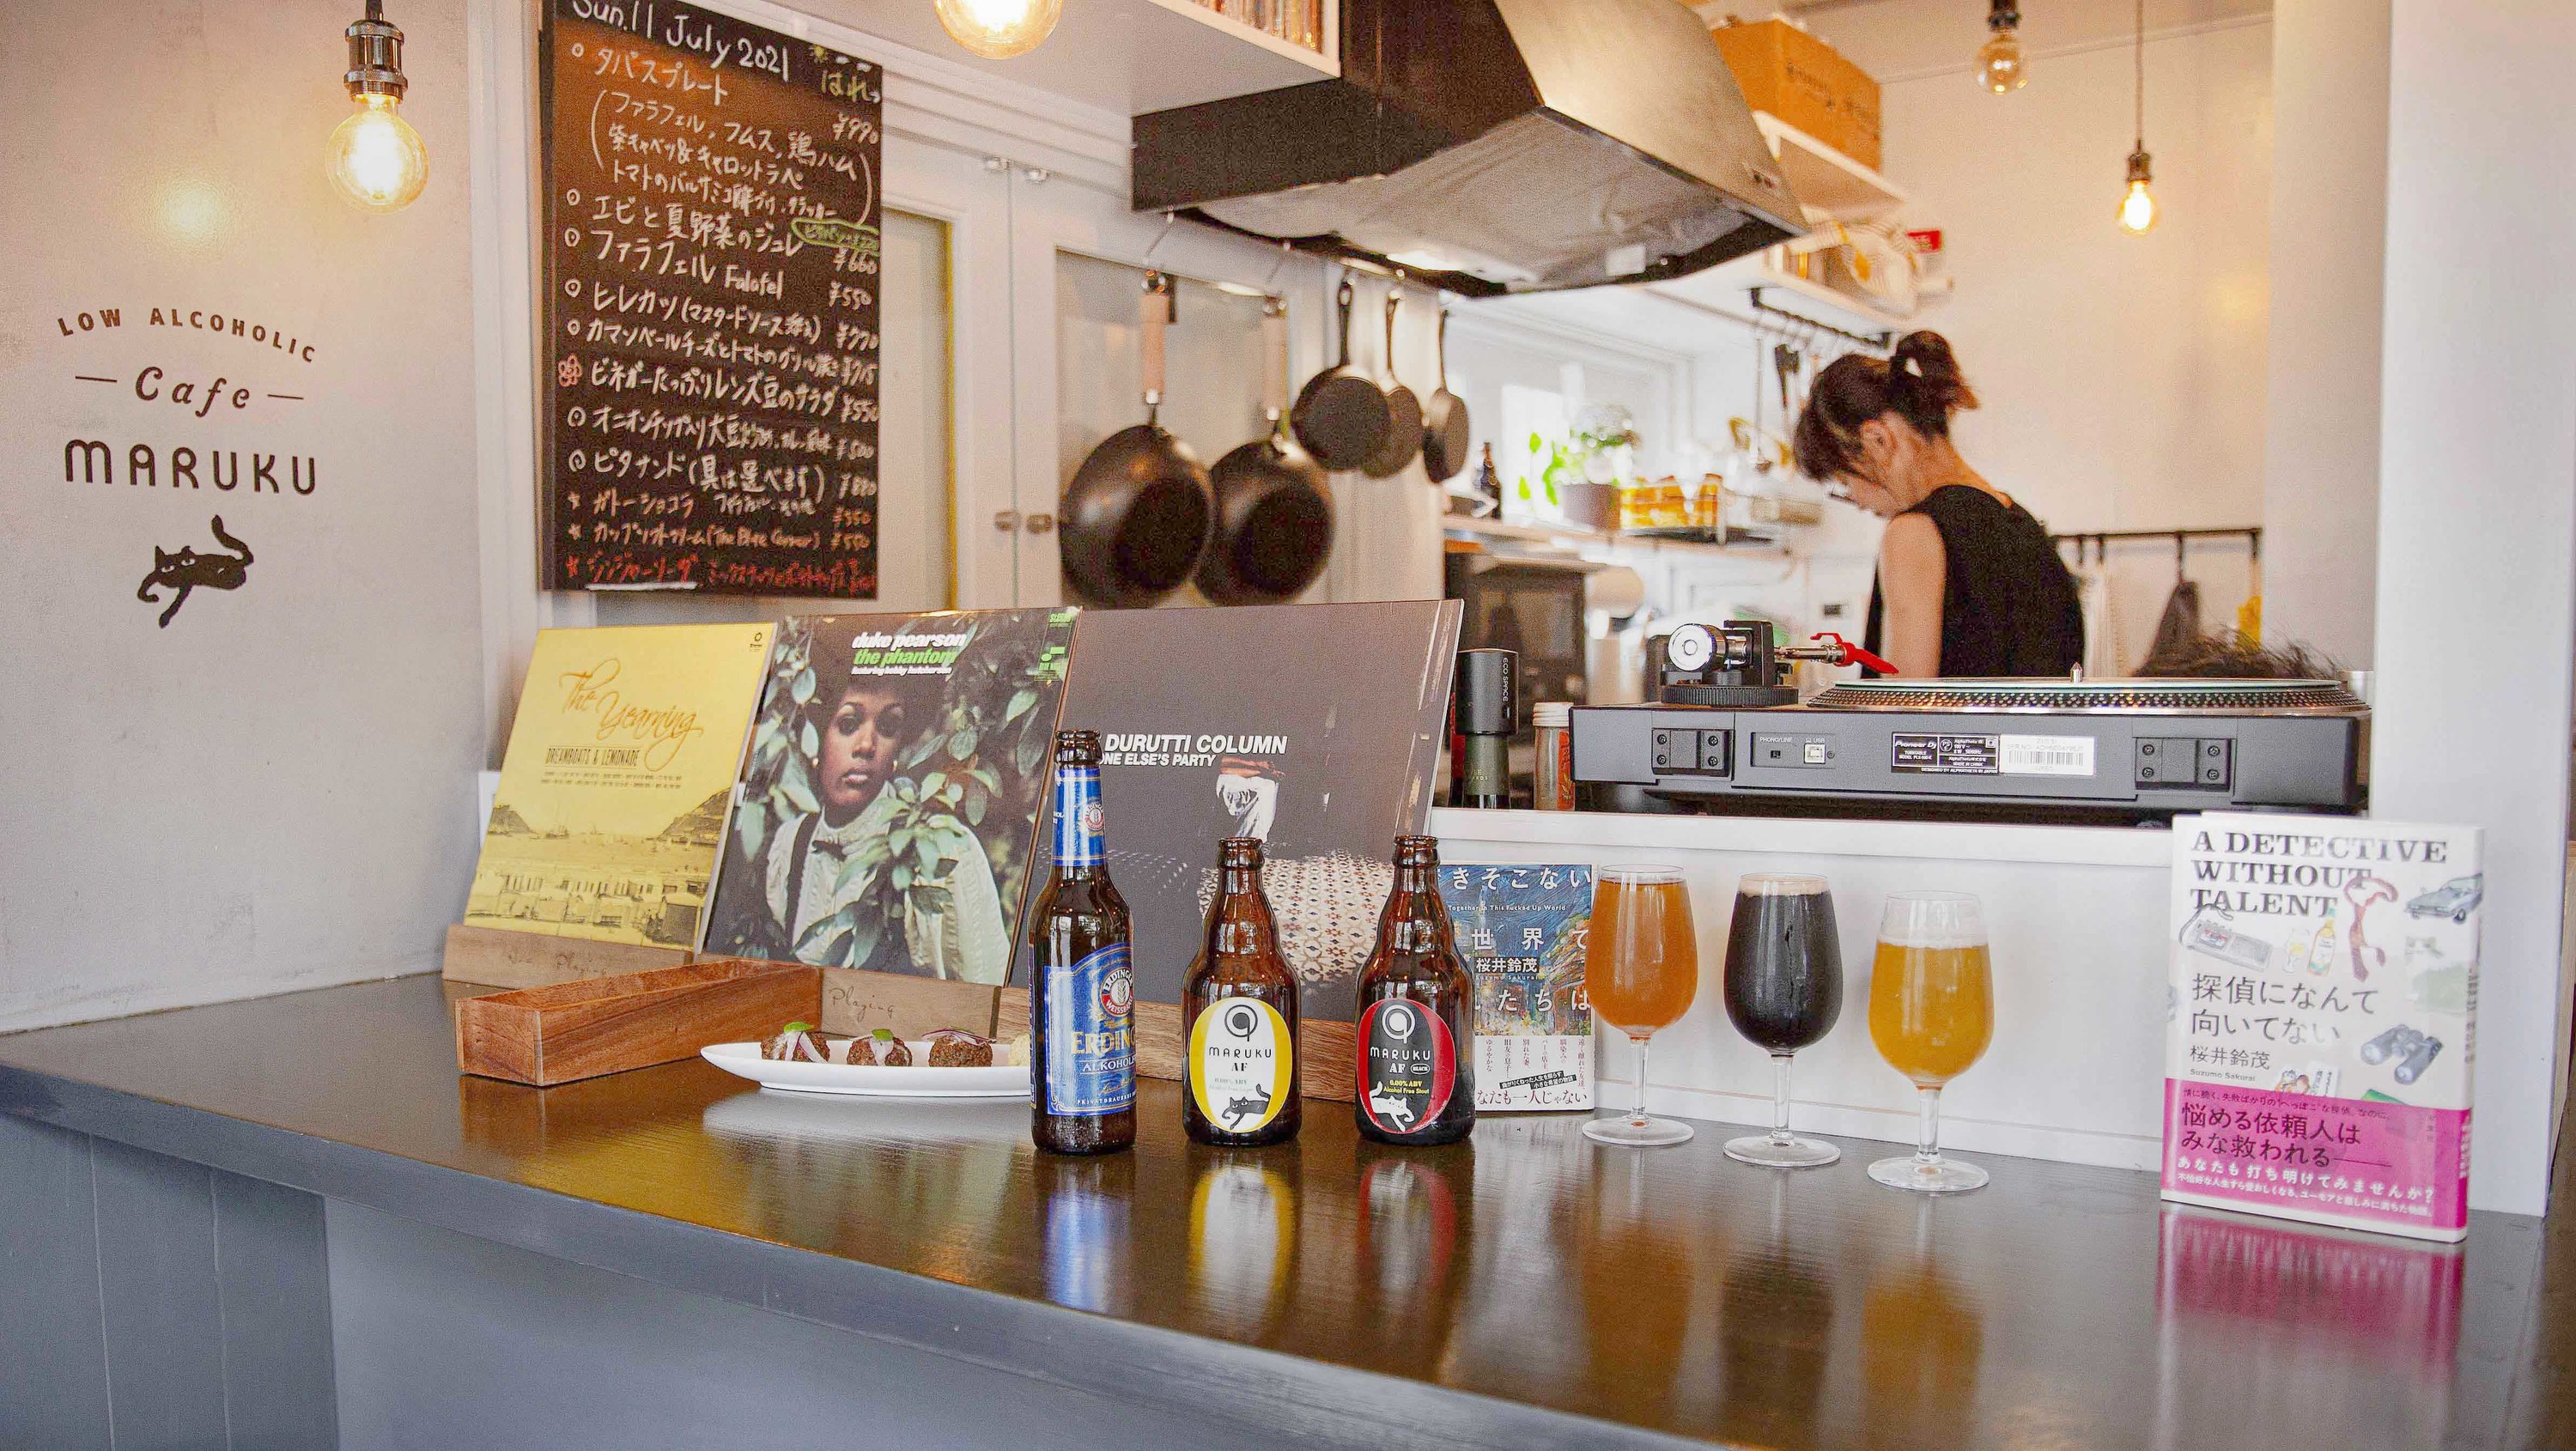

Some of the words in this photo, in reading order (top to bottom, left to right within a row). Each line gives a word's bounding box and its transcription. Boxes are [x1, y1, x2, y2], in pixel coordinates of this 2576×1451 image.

[665, 15, 730, 69] July
[737, 38, 790, 82] 2021
[596, 47, 728, 106] タパスプレート
[726, 266, 784, 301] Falafel
[58, 308, 121, 337] LOW
[149, 307, 316, 363] ALCOHOLIC
[135, 367, 250, 418] Cafe
[64, 439, 316, 496] MARUKU
[852, 632, 893, 648] duke
[890, 634, 967, 652] pearson
[854, 648, 882, 665] the
[880, 647, 958, 668] phantom
[559, 658, 621, 713] The
[597, 692, 704, 772] Yearning
[1105, 734, 1191, 753] DURUTTI
[1195, 735, 1288, 755] COLUMN
[1125, 753, 1170, 766] ELSE'S
[1172, 754, 1217, 767] PARTY
[2190, 831, 2215, 852] A
[2224, 831, 2446, 863] DETECTIVE
[1437, 867, 1590, 890] きそこない
[2190, 859, 2372, 889] WITHOUT
[2190, 889, 2338, 917] TALENT
[1476, 958, 1537, 973] 桜井鈴茂
[828, 987, 896, 1021] Playing
[2192, 973, 2379, 1015] 探偵になんて
[2191, 1009, 2341, 1046] 向いてない
[1209, 1047, 1271, 1058] MARUKU
[1231, 1062, 1248, 1072] AF
[1370, 1046, 1431, 1061] MARUKU
[2190, 1045, 2270, 1071] 桜井鈴茂
[1389, 1063, 1406, 1073] AF
[2190, 1069, 2222, 1079] Suzumo
[2225, 1072, 2256, 1082] Sakurai
[2181, 1102, 2361, 1145] 悩める依頼人は
